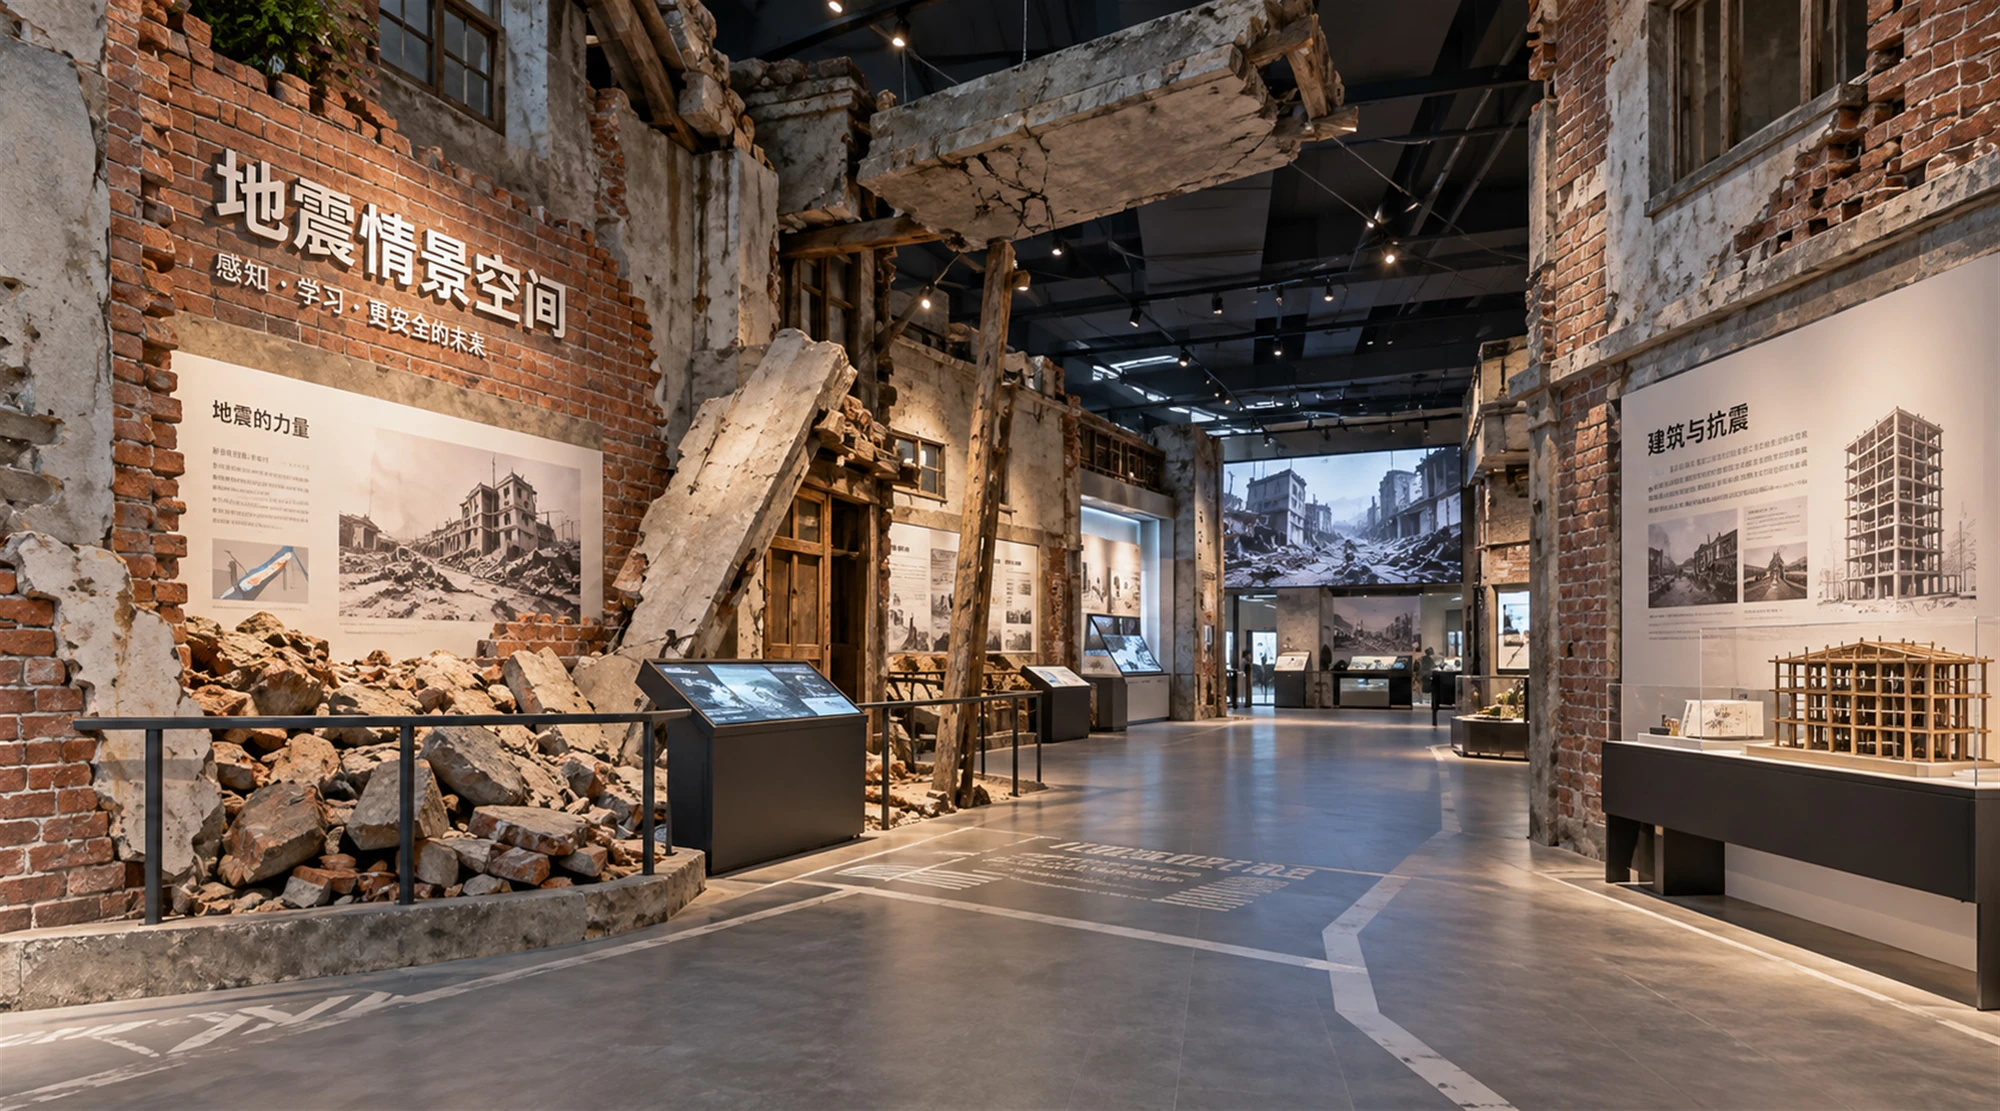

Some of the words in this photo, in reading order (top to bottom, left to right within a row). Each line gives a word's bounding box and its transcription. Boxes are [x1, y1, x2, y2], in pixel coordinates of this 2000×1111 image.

[213, 147, 567, 339] 地震情景空间
[212, 400, 310, 439] 地震的力量
[1647, 402, 1749, 457] 建筑与抗震
